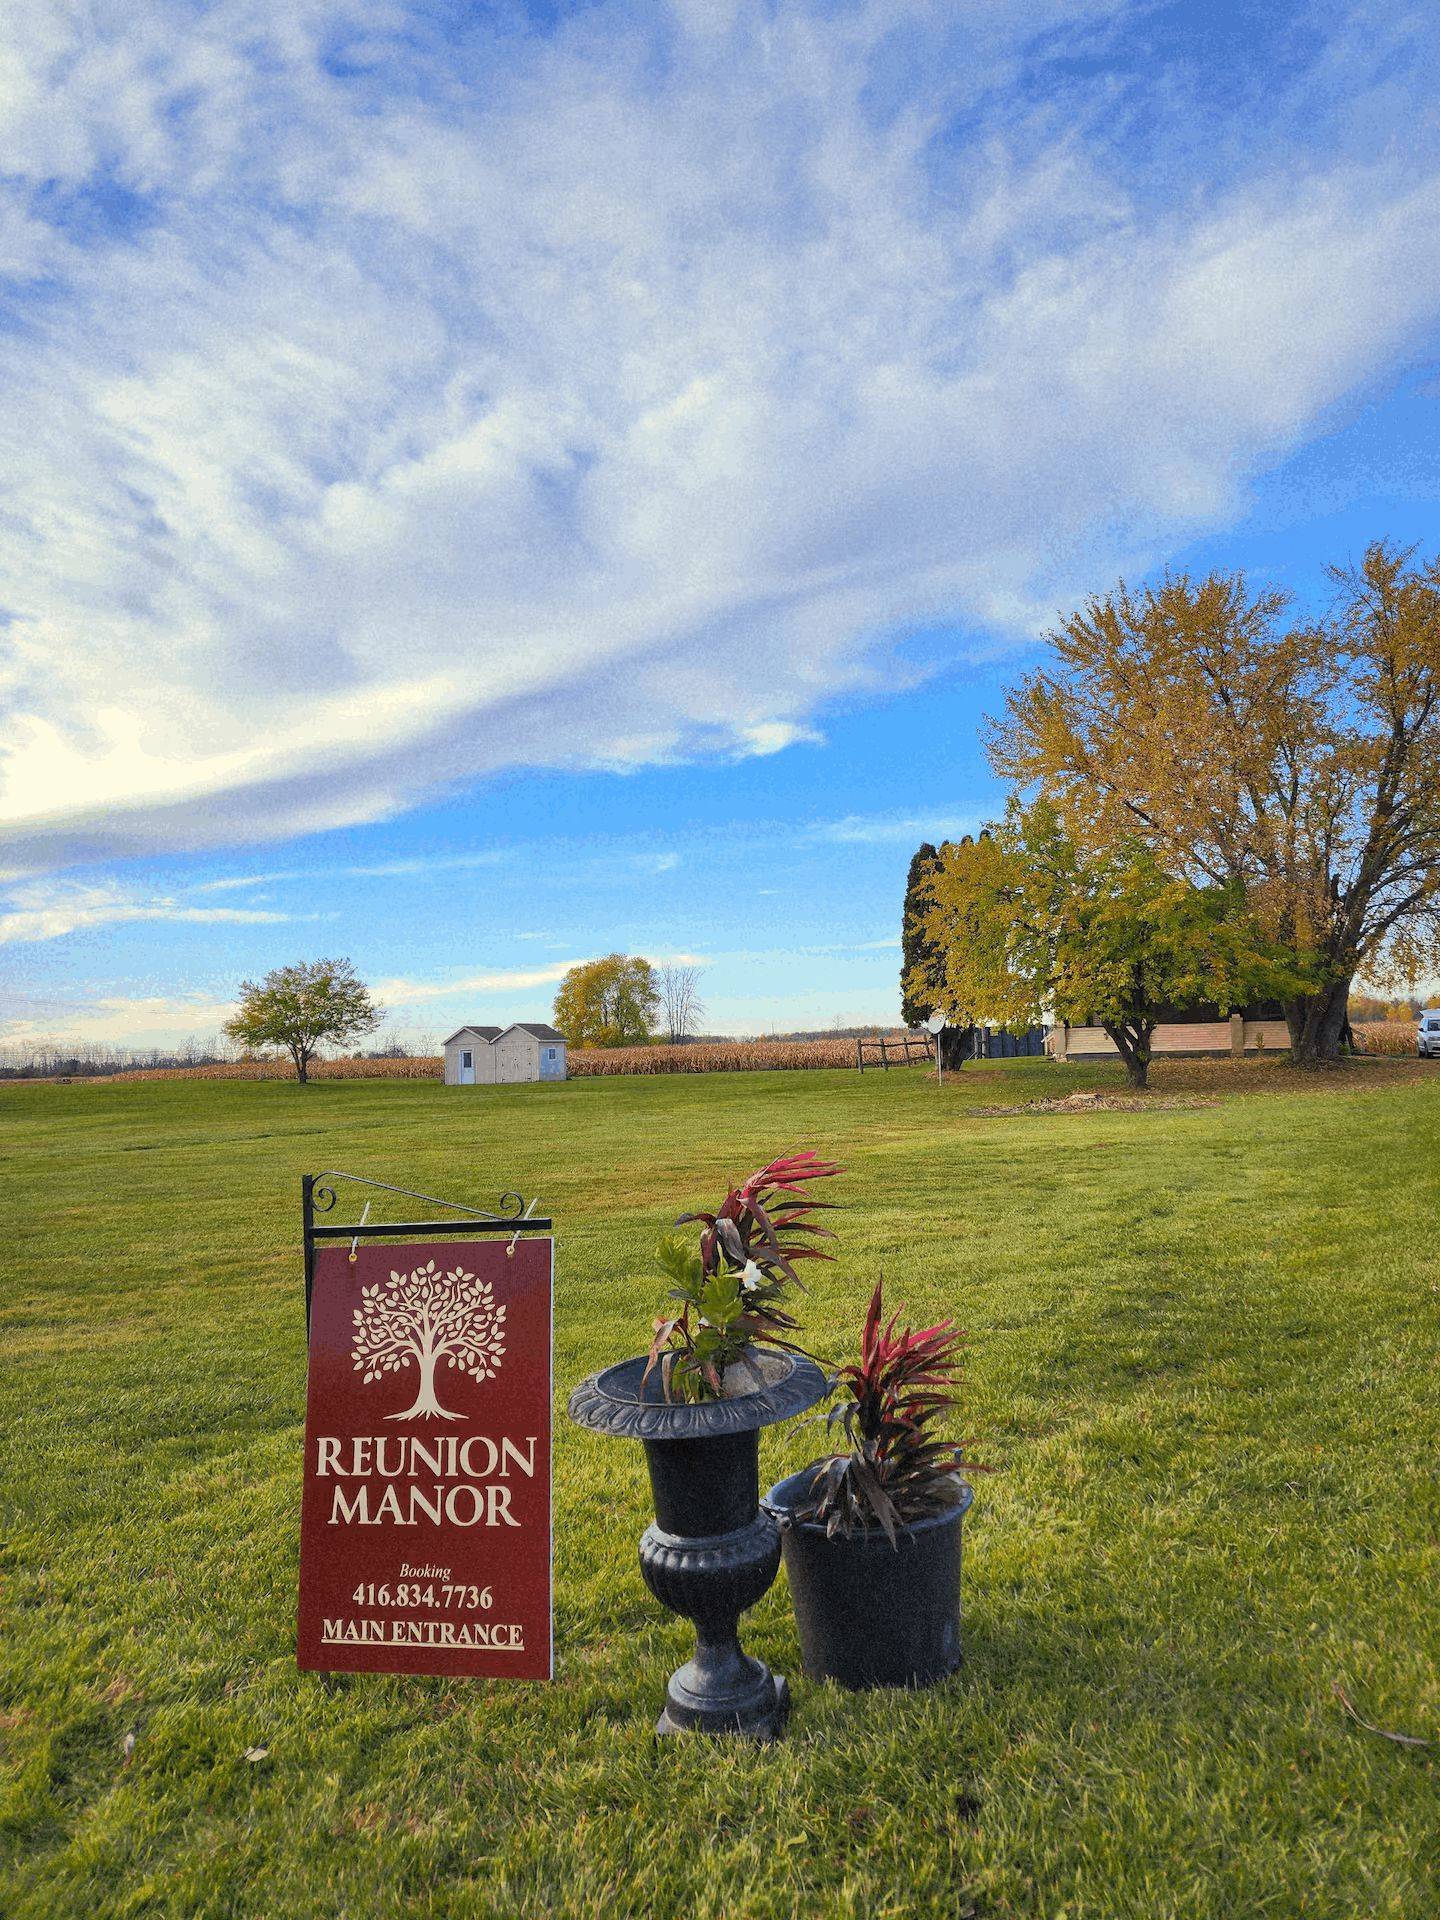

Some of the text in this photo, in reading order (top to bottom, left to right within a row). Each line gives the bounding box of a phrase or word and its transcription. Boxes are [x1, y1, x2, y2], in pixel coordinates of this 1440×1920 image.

[315, 1436, 538, 1478] REUNION
[327, 1484, 522, 1527] MANOR
[399, 1563, 452, 1582] Booking
[352, 1582, 493, 1610] 416.834.7736
[322, 1618, 524, 1647] MAIN ENTRANCE
